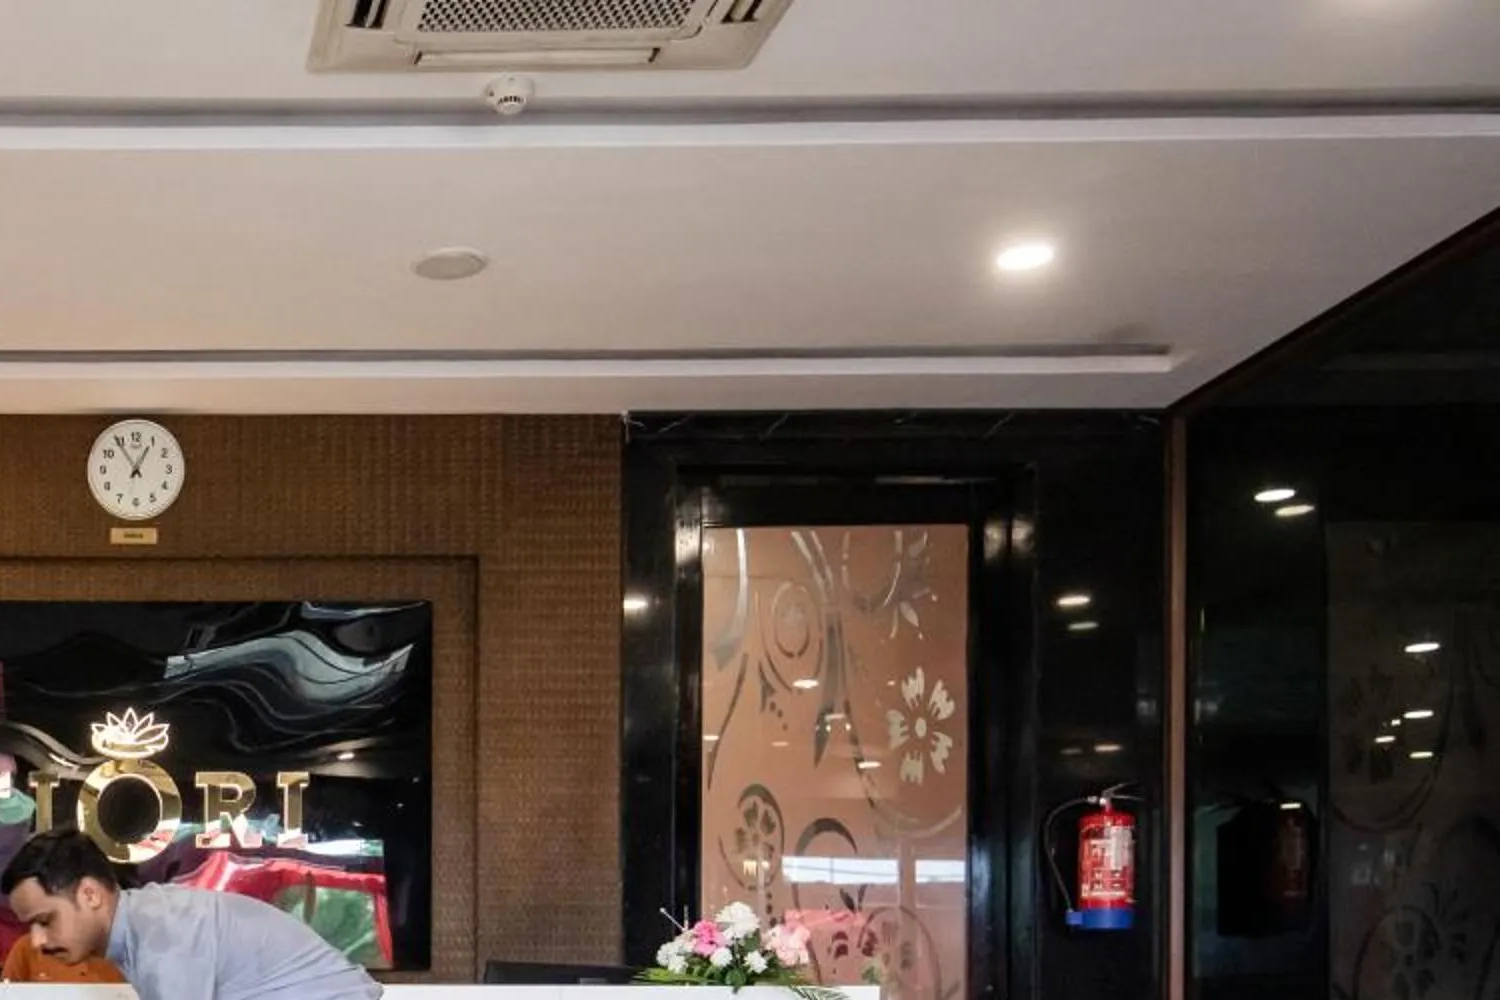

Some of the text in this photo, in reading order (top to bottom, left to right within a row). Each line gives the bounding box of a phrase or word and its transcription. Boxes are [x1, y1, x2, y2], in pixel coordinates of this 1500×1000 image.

[131, 431, 142, 443] 12
[103, 449, 115, 459] 10
[161, 448, 168, 459] 2
[100, 465, 107, 475] 9
[165, 464, 173, 475] 3
[103, 481, 111, 491] 8
[161, 480, 168, 490] 4
[116, 493, 123, 504] 7
[132, 497, 140, 507] 6
[149, 492, 157, 503] 5
